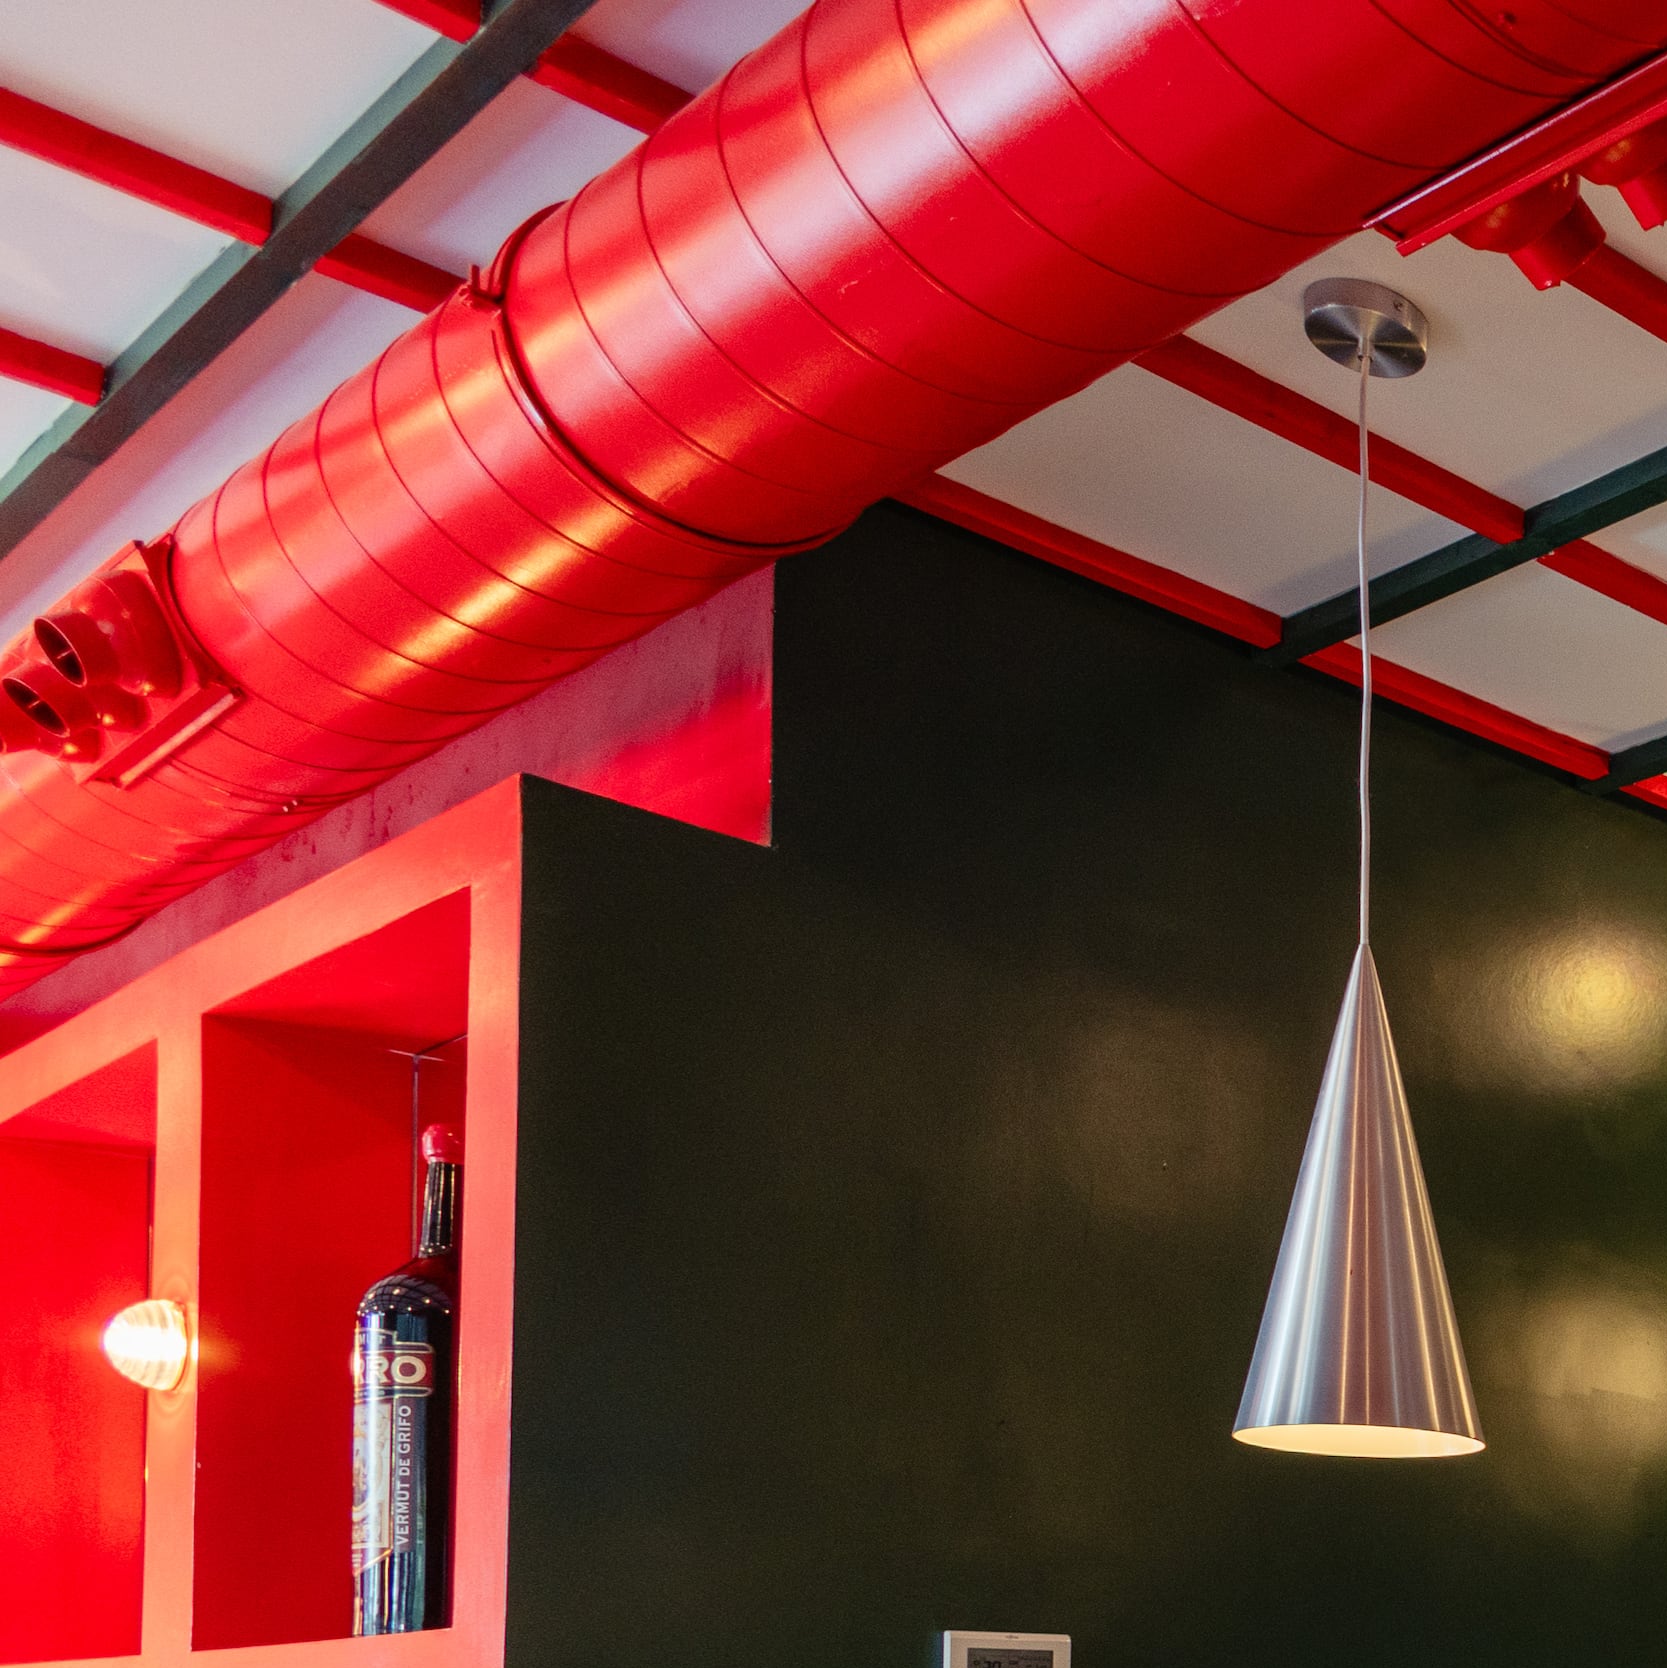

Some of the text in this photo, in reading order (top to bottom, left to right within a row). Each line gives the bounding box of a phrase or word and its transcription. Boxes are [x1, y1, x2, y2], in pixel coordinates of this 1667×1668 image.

[396, 1405, 412, 1546] VERMUT DE GRIFO
